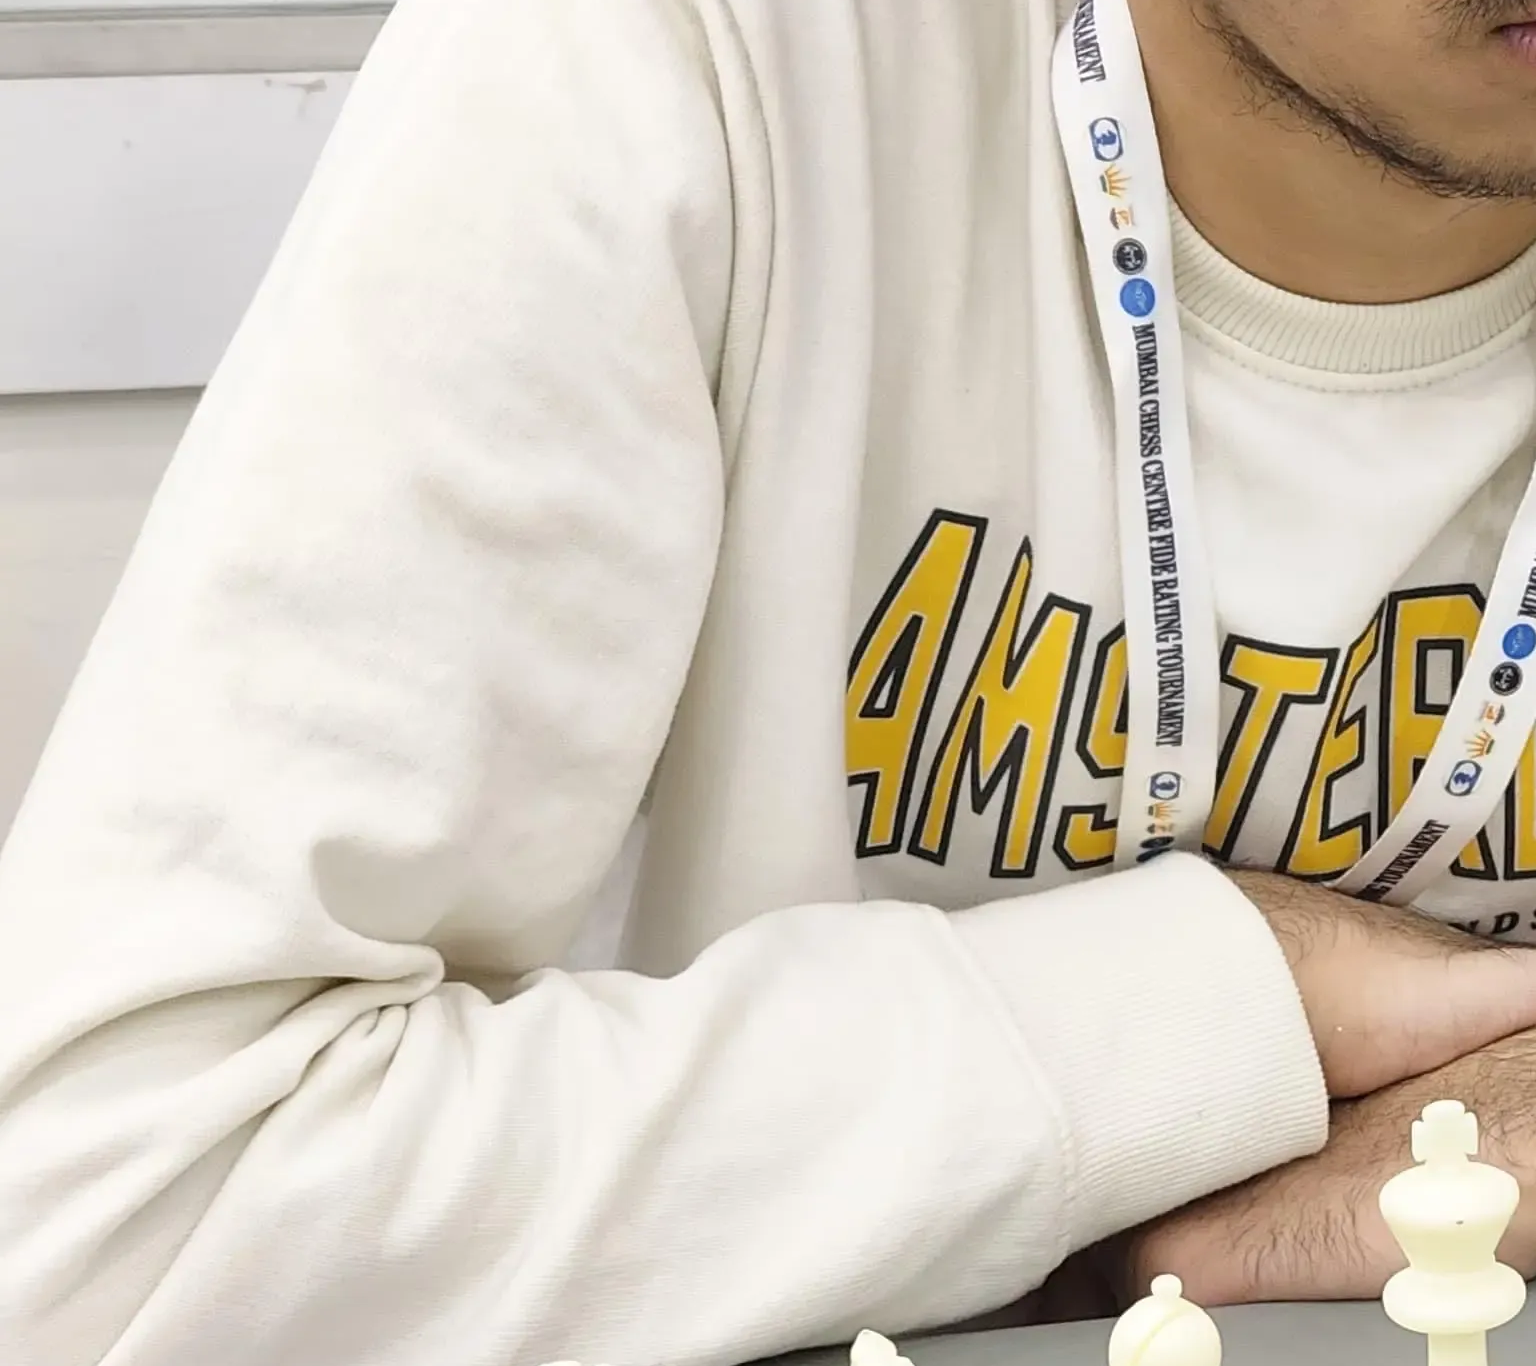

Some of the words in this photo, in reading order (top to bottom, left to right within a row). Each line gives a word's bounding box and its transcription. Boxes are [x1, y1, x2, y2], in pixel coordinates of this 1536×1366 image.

[1132, 322, 1159, 398] MUMBAI
[1138, 399, 1162, 458] CHESS
[1141, 458, 1174, 533] CENTRE
[1148, 531, 1178, 578] FIDE
[1152, 575, 1183, 644] RATING
[1156, 644, 1185, 747] TOURNAMENT
[1376, 818, 1451, 887] TOURNAMENT
